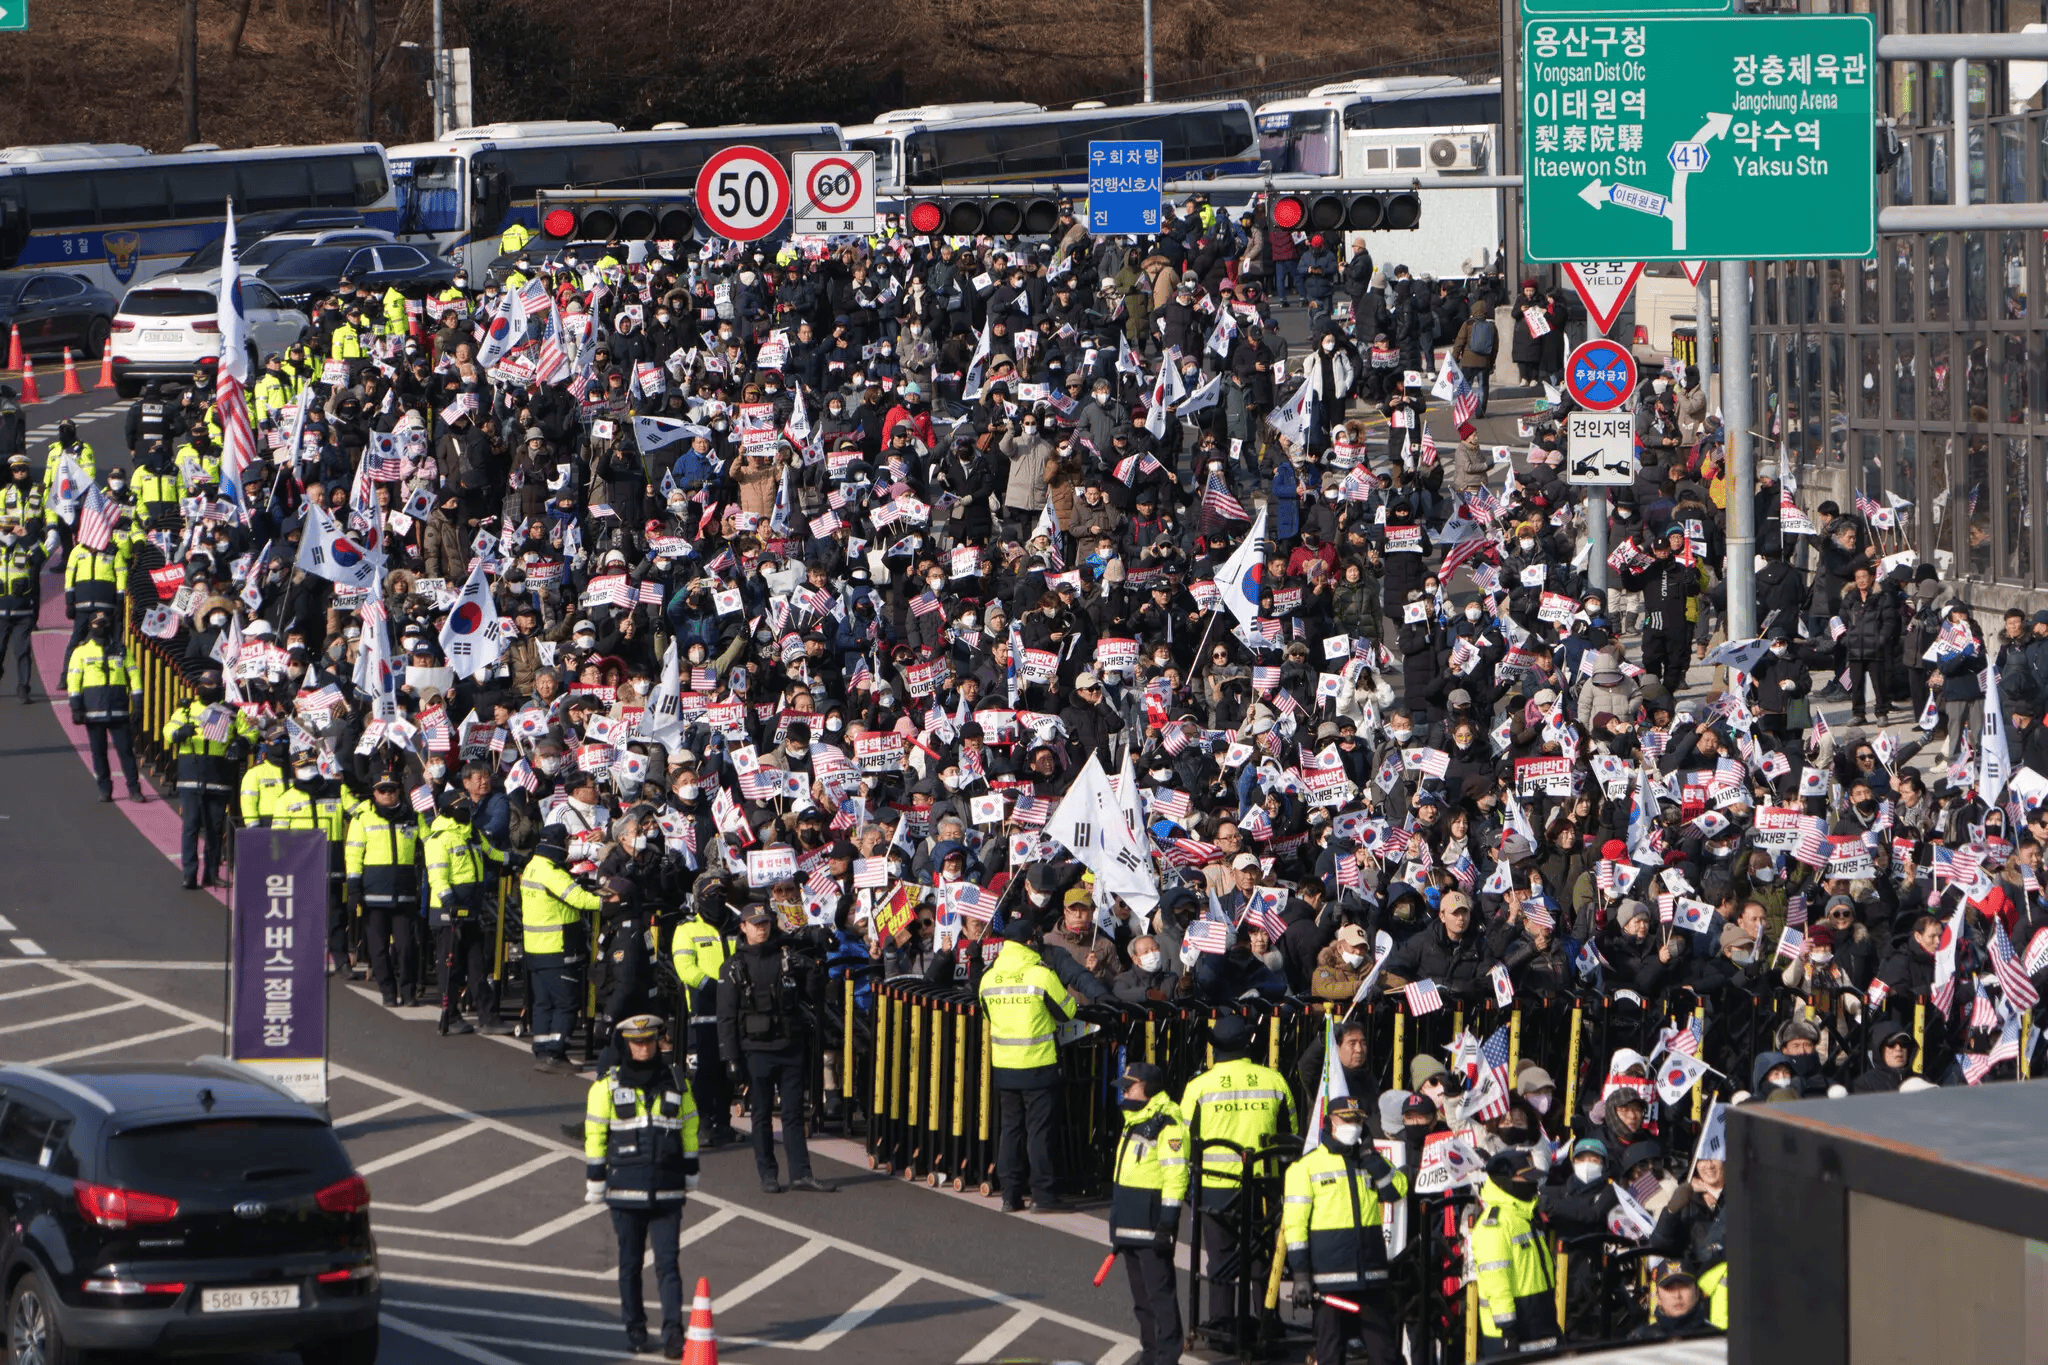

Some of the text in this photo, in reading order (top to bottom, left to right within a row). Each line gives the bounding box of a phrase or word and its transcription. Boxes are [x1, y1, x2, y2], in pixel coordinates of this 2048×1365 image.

[1533, 26, 1647, 58] 용산구청
[1534, 60, 1646, 86] Yongsan Dist Ofc
[1733, 53, 1867, 86] 장충체육관
[1533, 88, 1647, 120] 이태원역
[1732, 90, 1838, 114] Jangchung Arena
[1535, 124, 1644, 153] 梨泰院驛
[1733, 119, 1821, 152] 약수역
[1091, 148, 1159, 166] 우회차량
[1677, 146, 1703, 168] 41
[1534, 156, 1647, 177] Itaewon Stn
[1733, 156, 1828, 177] Yaksu Stn
[817, 174, 850, 196] 60
[1090, 176, 1161, 193] 진행신호시
[717, 170, 770, 218] 50
[1615, 189, 1662, 214] 이태원로
[1585, 276, 1624, 286] YIELD
[1575, 369, 1628, 382] 주정차금지
[1573, 419, 1631, 439] 견인지역
[743, 432, 778, 444] 탄핵반대
[1335, 445, 1367, 457] 탄핵반대
[1384, 526, 1421, 541] 탄핵반대
[1385, 541, 1408, 551] 이재명
[333, 596, 358, 606] 이재명
[1274, 588, 1302, 604] 핵반대
[1539, 608, 1562, 619] 이재명
[241, 642, 263, 659] 반대
[1098, 642, 1140, 656] 탄핵반대
[1025, 651, 1058, 668] 핵반대
[908, 658, 947, 684] 탄핵반대
[911, 678, 936, 695] 이재명
[709, 706, 744, 722] 핵반대
[756, 704, 775, 719] 반대
[854, 735, 902, 753] 탄핵반대
[1516, 761, 1570, 778] 탄핵반대
[1304, 770, 1344, 788] 탄핵반대
[1549, 776, 1570, 788] 구속
[1305, 788, 1332, 803] 이재명
[1758, 813, 1799, 828] 탄핵반
[1754, 831, 1785, 844] 이재명
[1833, 840, 1870, 860] 탄핵반
[757, 869, 792, 882] 부정선거
[1827, 860, 1858, 874] 이재명
[262, 874, 295, 1048] 임시 버스 정류장
[989, 996, 1032, 1005] POLICE
[1219, 1073, 1259, 1089] 경찰
[1214, 1101, 1270, 1113] POLICE
[1417, 1166, 1448, 1187] 이재명
[249, 1288, 291, 1306] 9537
